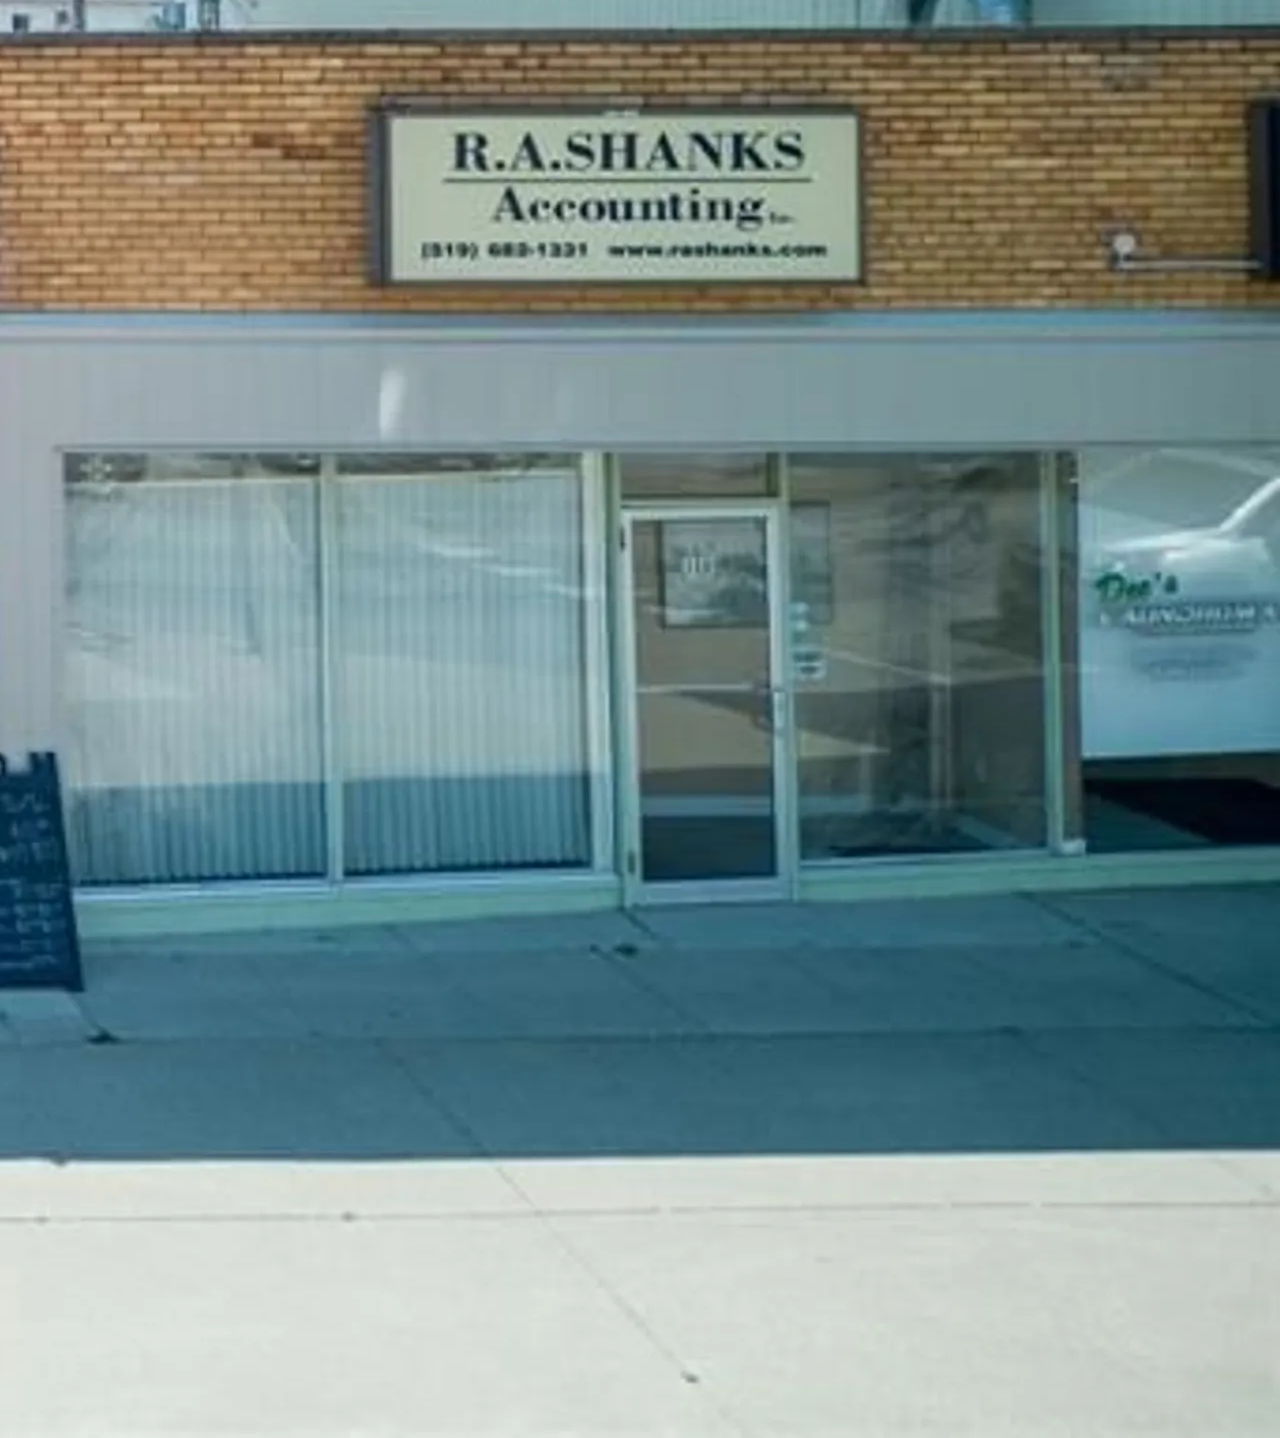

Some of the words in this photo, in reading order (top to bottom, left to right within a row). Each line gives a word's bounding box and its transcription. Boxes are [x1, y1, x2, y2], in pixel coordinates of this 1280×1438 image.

[452, 132, 805, 172] R.A.SHANKS
[493, 186, 765, 231] Accounting
[421, 242, 478, 259] (519)
[608, 241, 828, 259] www.rashanks.com
